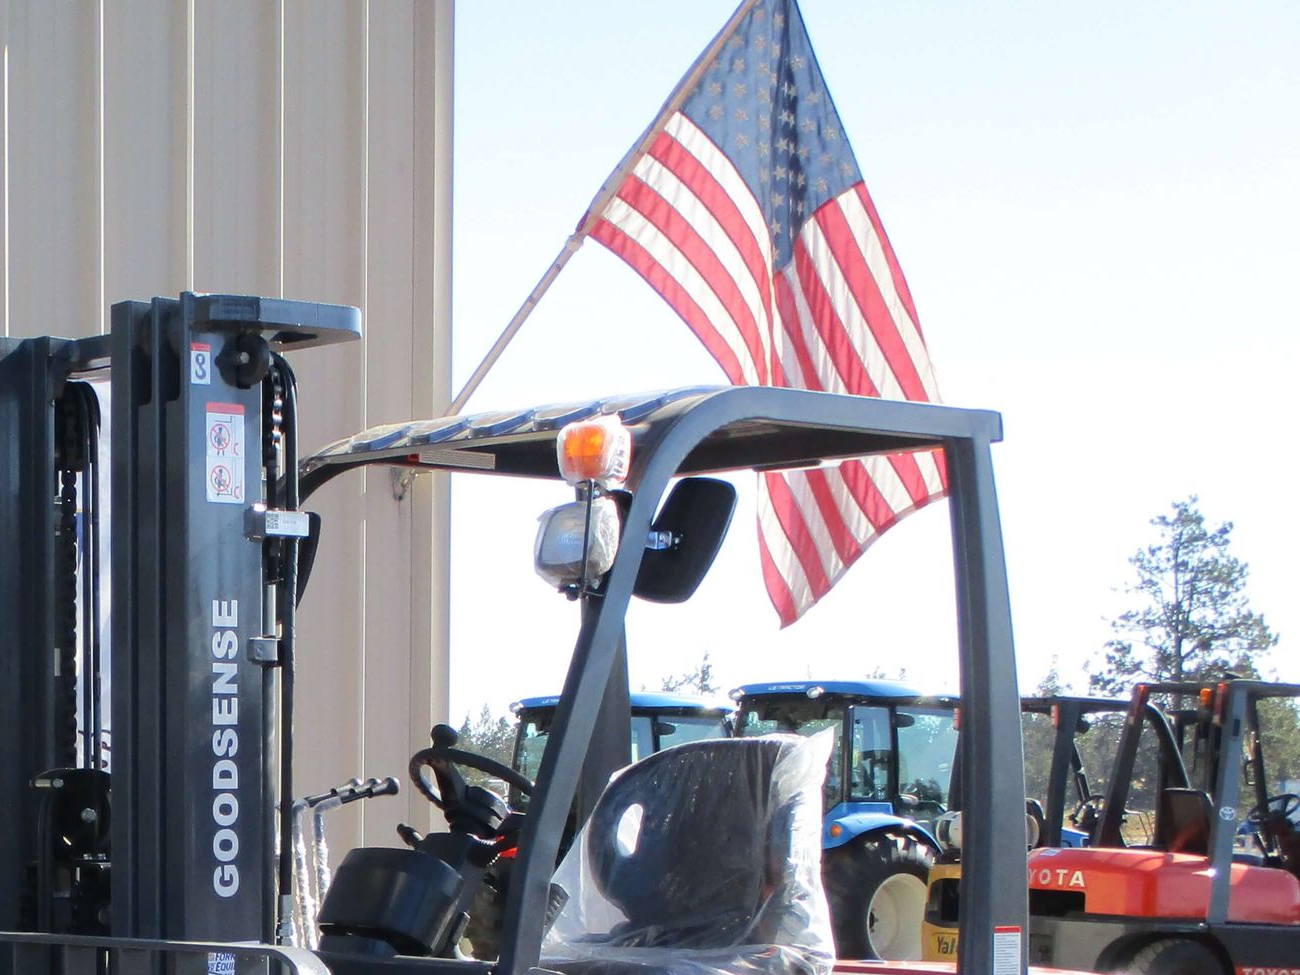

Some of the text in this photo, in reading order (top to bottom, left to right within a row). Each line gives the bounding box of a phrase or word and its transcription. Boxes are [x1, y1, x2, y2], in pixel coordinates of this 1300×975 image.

[211, 599, 240, 898] GOODSENSE
[1027, 868, 1086, 887] YOTA
[936, 935, 958, 955] Yal
[215, 952, 236, 962] FORK
